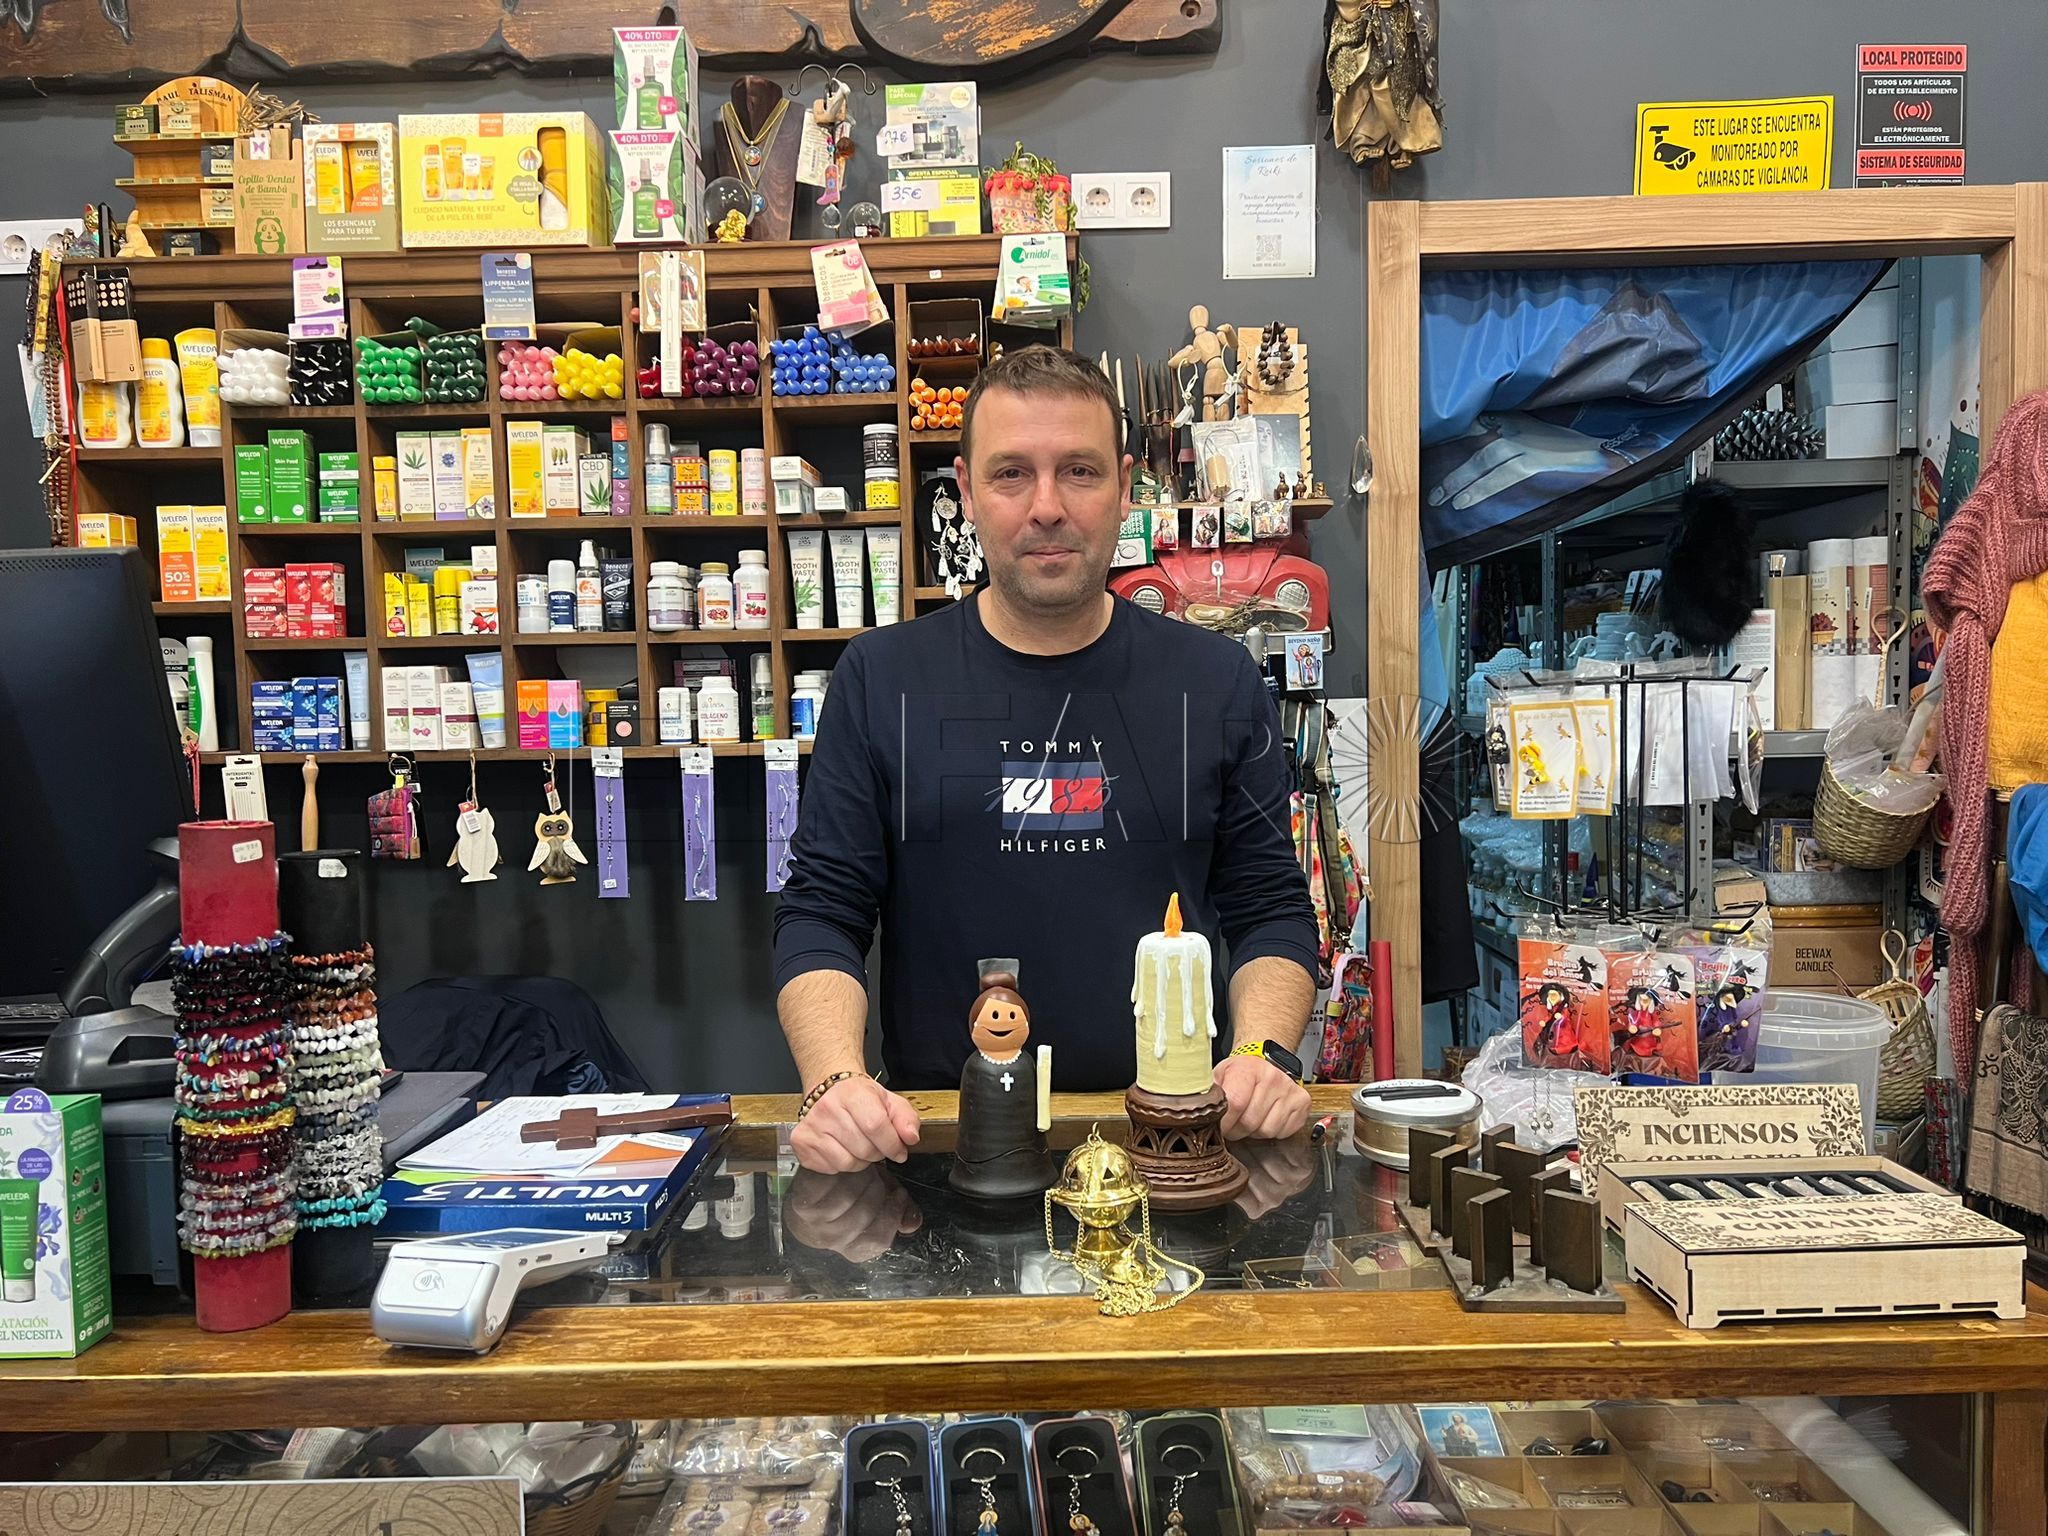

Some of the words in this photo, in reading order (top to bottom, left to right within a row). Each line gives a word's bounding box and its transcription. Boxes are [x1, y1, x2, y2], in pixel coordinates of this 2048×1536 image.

[624, 32, 643, 40] 40%
[645, 31, 662, 40] DTO
[1863, 51, 1897, 65] LOCAL
[1901, 51, 1963, 65] PROTEGIDO
[1913, 78, 1951, 86] ARTÍCULOS
[188, 86, 233, 102] TALISMAN
[1693, 118, 1716, 137] ESTE
[1718, 117, 1748, 136] LUGAR
[1751, 116, 1763, 134] SE
[1766, 113, 1821, 133] ENCUENTRA
[620, 135, 639, 143] 40%
[641, 134, 658, 142] DTO
[1874, 134, 1950, 142] ELECTRÓNICAMENTE
[1711, 143, 1776, 161] MONITOREADO
[1780, 140, 1798, 157] POR
[1860, 156, 1897, 168] SISTEMA
[1900, 156, 1911, 168] DE
[1913, 155, 1962, 168] SEGURIDAD
[238, 175, 264, 185] Cepillo
[266, 174, 296, 183] Dental
[1697, 167, 1741, 188] CÁMARAS
[1743, 168, 1755, 186] DE
[1758, 165, 1809, 185] VIGILANCIA
[245, 185, 255, 193] de
[413, 206, 443, 214] CUIDADO
[444, 205, 475, 213] NATURAL
[482, 204, 505, 213] EFICAZ
[337, 219, 377, 227] ESENCIALES
[327, 227, 345, 235] PARA
[182, 345, 217, 353] WELEDA
[511, 431, 539, 439] WELEDA
[582, 461, 605, 471] CBD
[161, 515, 188, 523] WELEDA
[165, 571, 191, 583] 50%
[518, 697, 547, 709] BOOST
[1000, 740, 1103, 753] TOMMY
[984, 775, 1120, 814] 1985
[1000, 838, 1106, 852] HILFIGER
[1795, 947, 1832, 959] BEEWAX
[1547, 958, 1577, 968] Brujita
[1795, 961, 1834, 972] CANDLES
[1542, 968, 1557, 977] del
[1559, 969, 1584, 980] Amor
[1627, 977, 1642, 986] del
[14, 1095, 43, 1110] 25%
[1643, 1122, 1799, 1146] INCIENSOS
[1717, 1204, 1896, 1221] INCIENSOS
[1730, 1214, 1922, 1232] COFRADES
[12, 1329, 63, 1341] NECESITA
